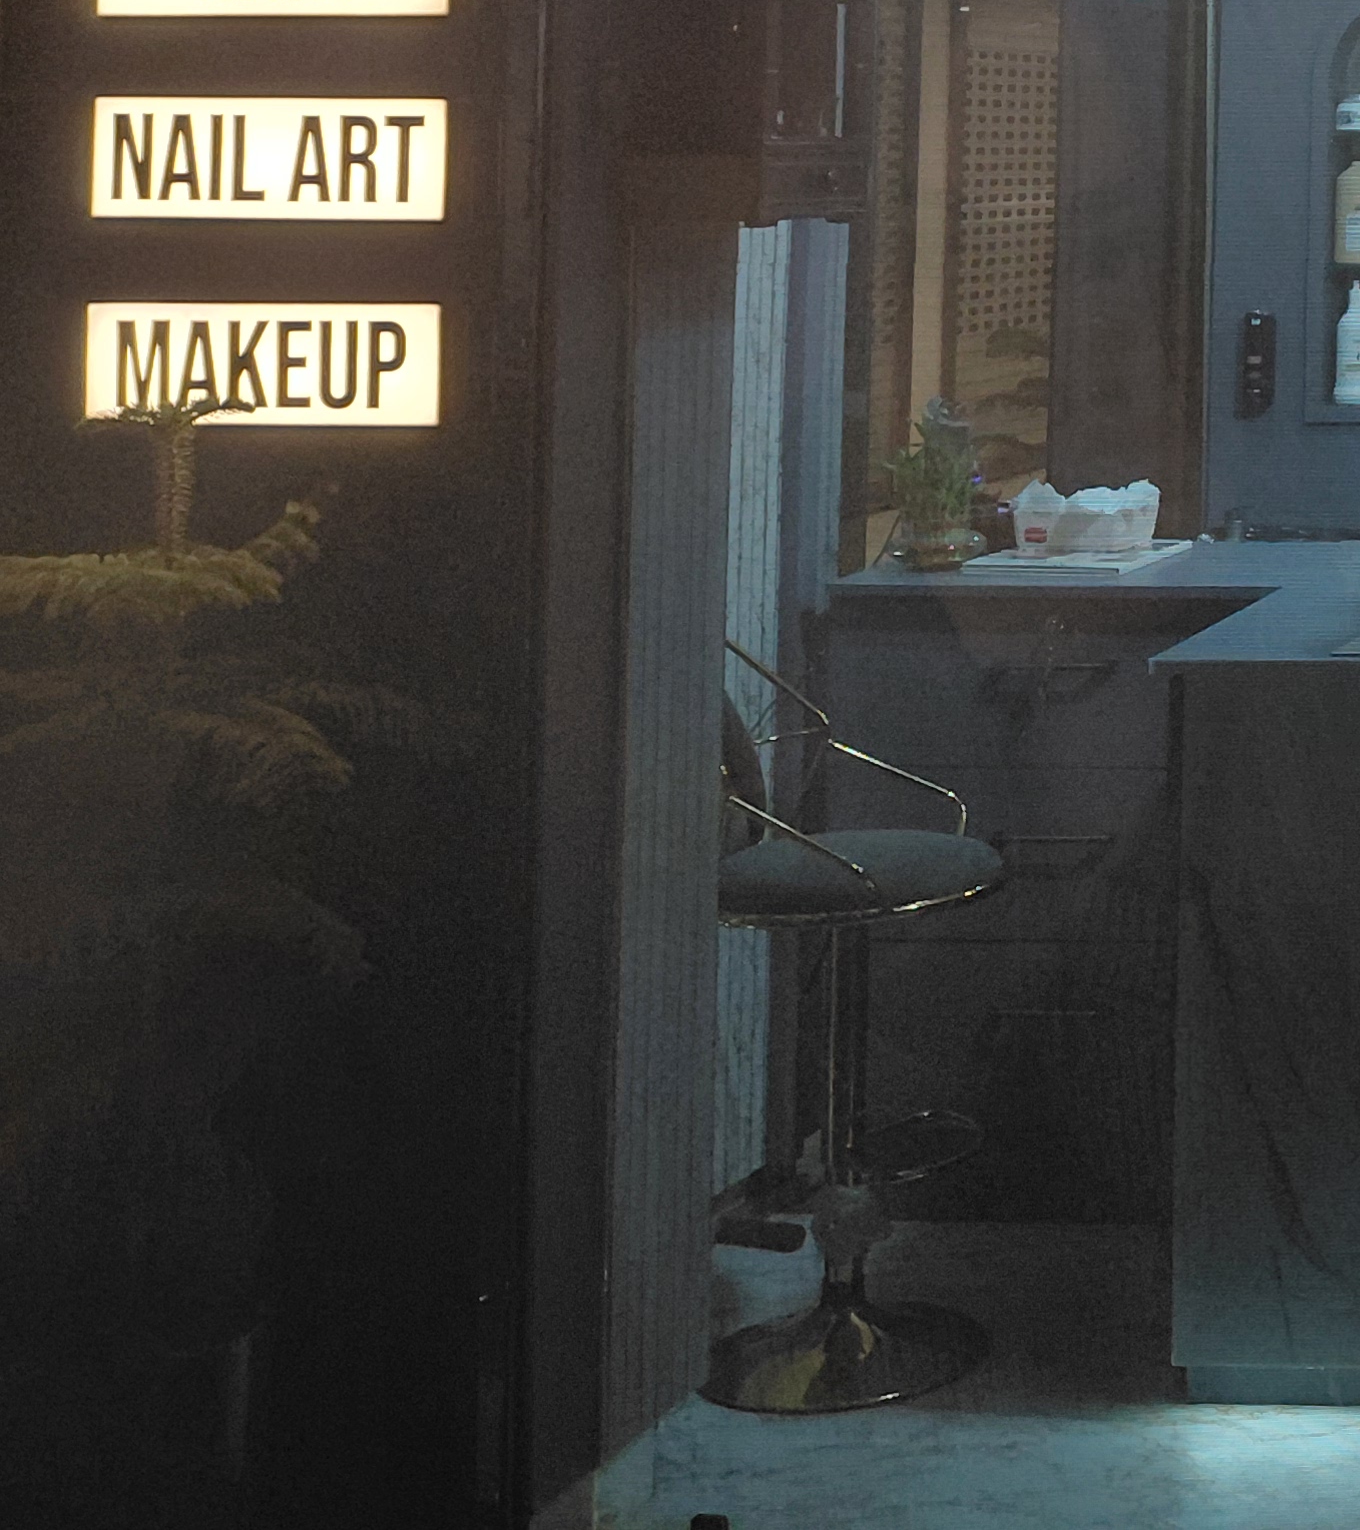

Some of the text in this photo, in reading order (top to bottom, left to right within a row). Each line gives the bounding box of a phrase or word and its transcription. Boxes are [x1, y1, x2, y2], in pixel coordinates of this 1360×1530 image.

[110, 112, 426, 204] NAIL ART
[116, 319, 407, 409] MAKEUP
